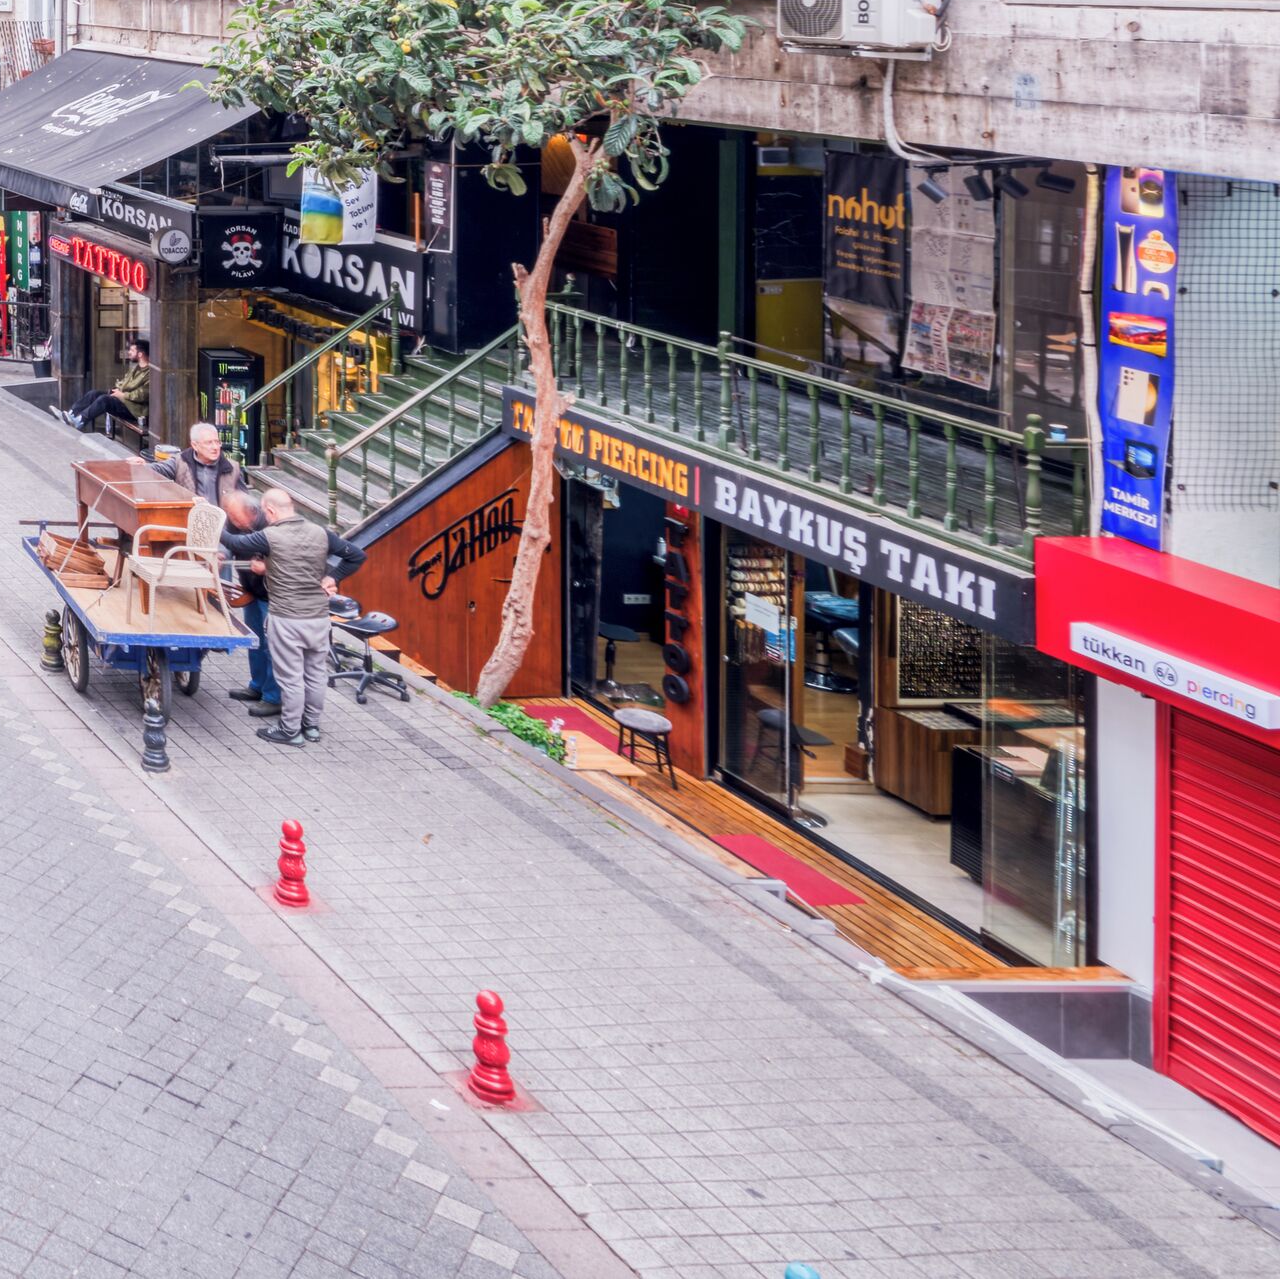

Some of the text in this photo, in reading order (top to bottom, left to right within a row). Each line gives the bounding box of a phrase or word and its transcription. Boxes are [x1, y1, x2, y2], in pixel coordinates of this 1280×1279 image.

[345, 196, 360, 207] Sev
[827, 187, 905, 230] nohut
[224, 224, 257, 236] KORSAN
[161, 245, 188, 255] TOBACCO
[71, 236, 145, 292] TATTOO
[231, 270, 256, 279] PİLAVI
[282, 235, 415, 311] KORSAN
[511, 400, 996, 620] TAOO PIERCING BAYKUŞ TAKI
[1109, 486, 1150, 511] TAMİR
[1103, 502, 1158, 529] MERKEZİ
[1083, 635, 1257, 720] tükkan 6/a piercing
